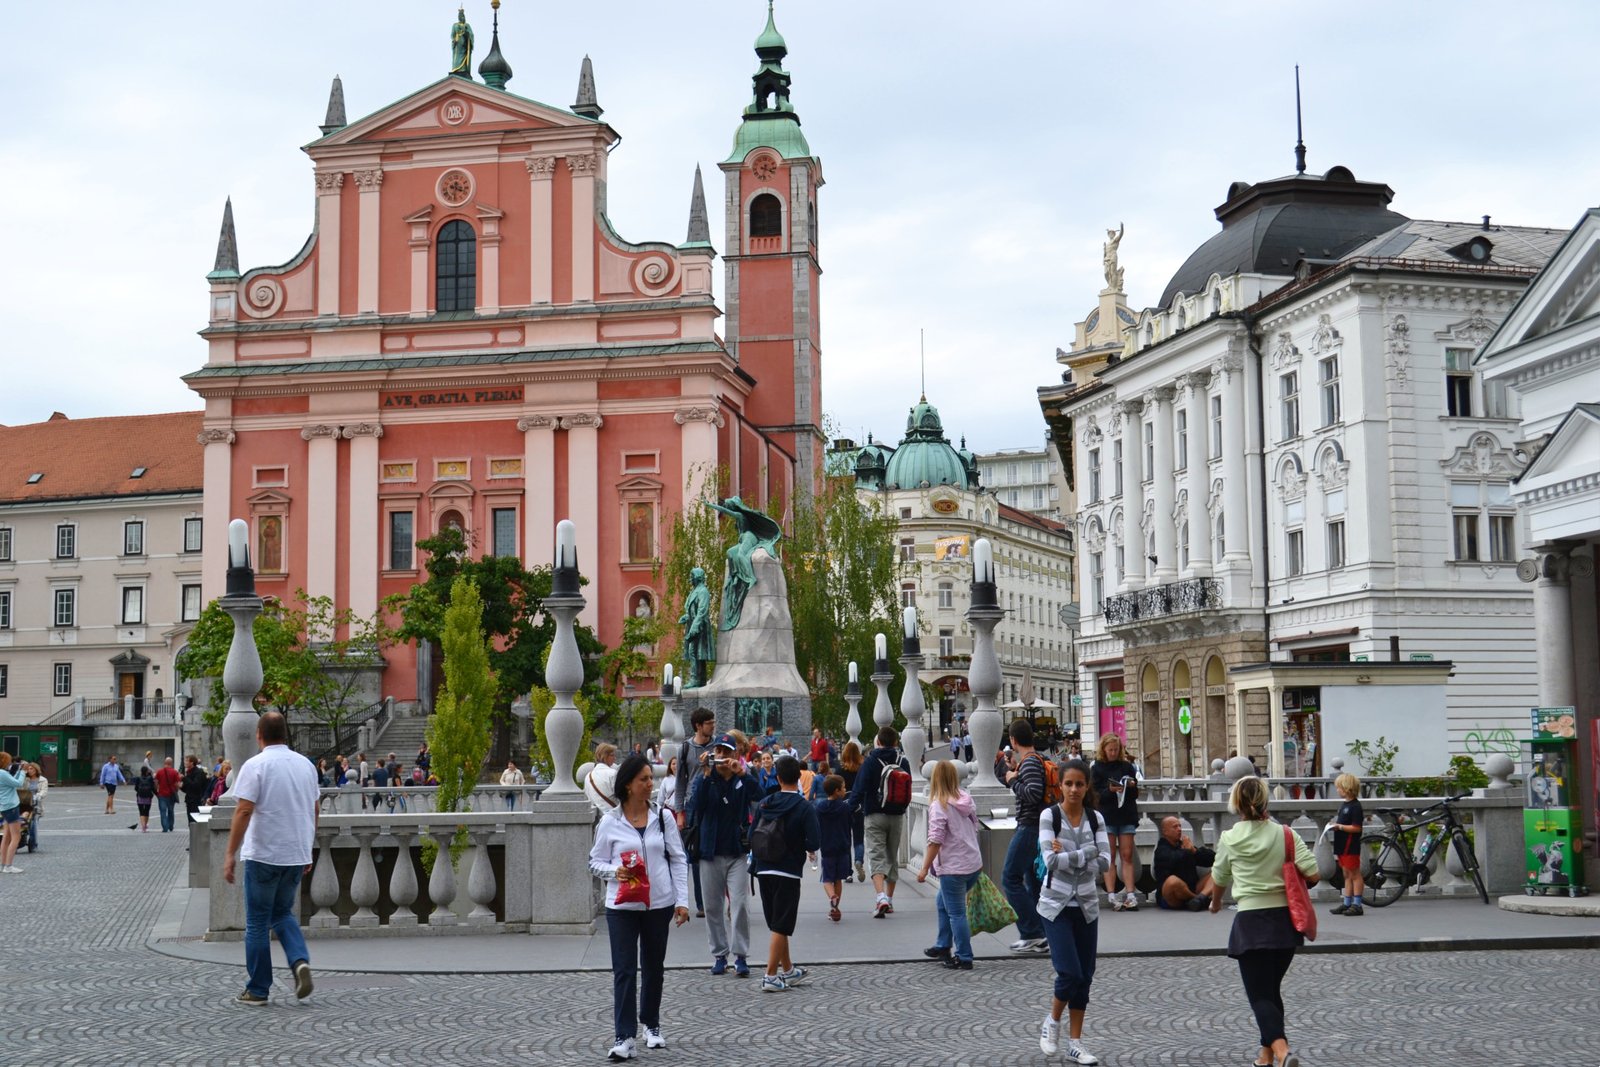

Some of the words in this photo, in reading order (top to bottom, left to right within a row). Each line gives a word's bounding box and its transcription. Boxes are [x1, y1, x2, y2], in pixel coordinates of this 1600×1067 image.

[384, 395, 417, 408] AVE,
[418, 393, 468, 405] GRATIA
[475, 390, 522, 402] PLENA!
[1303, 694, 1316, 706] kiosk
